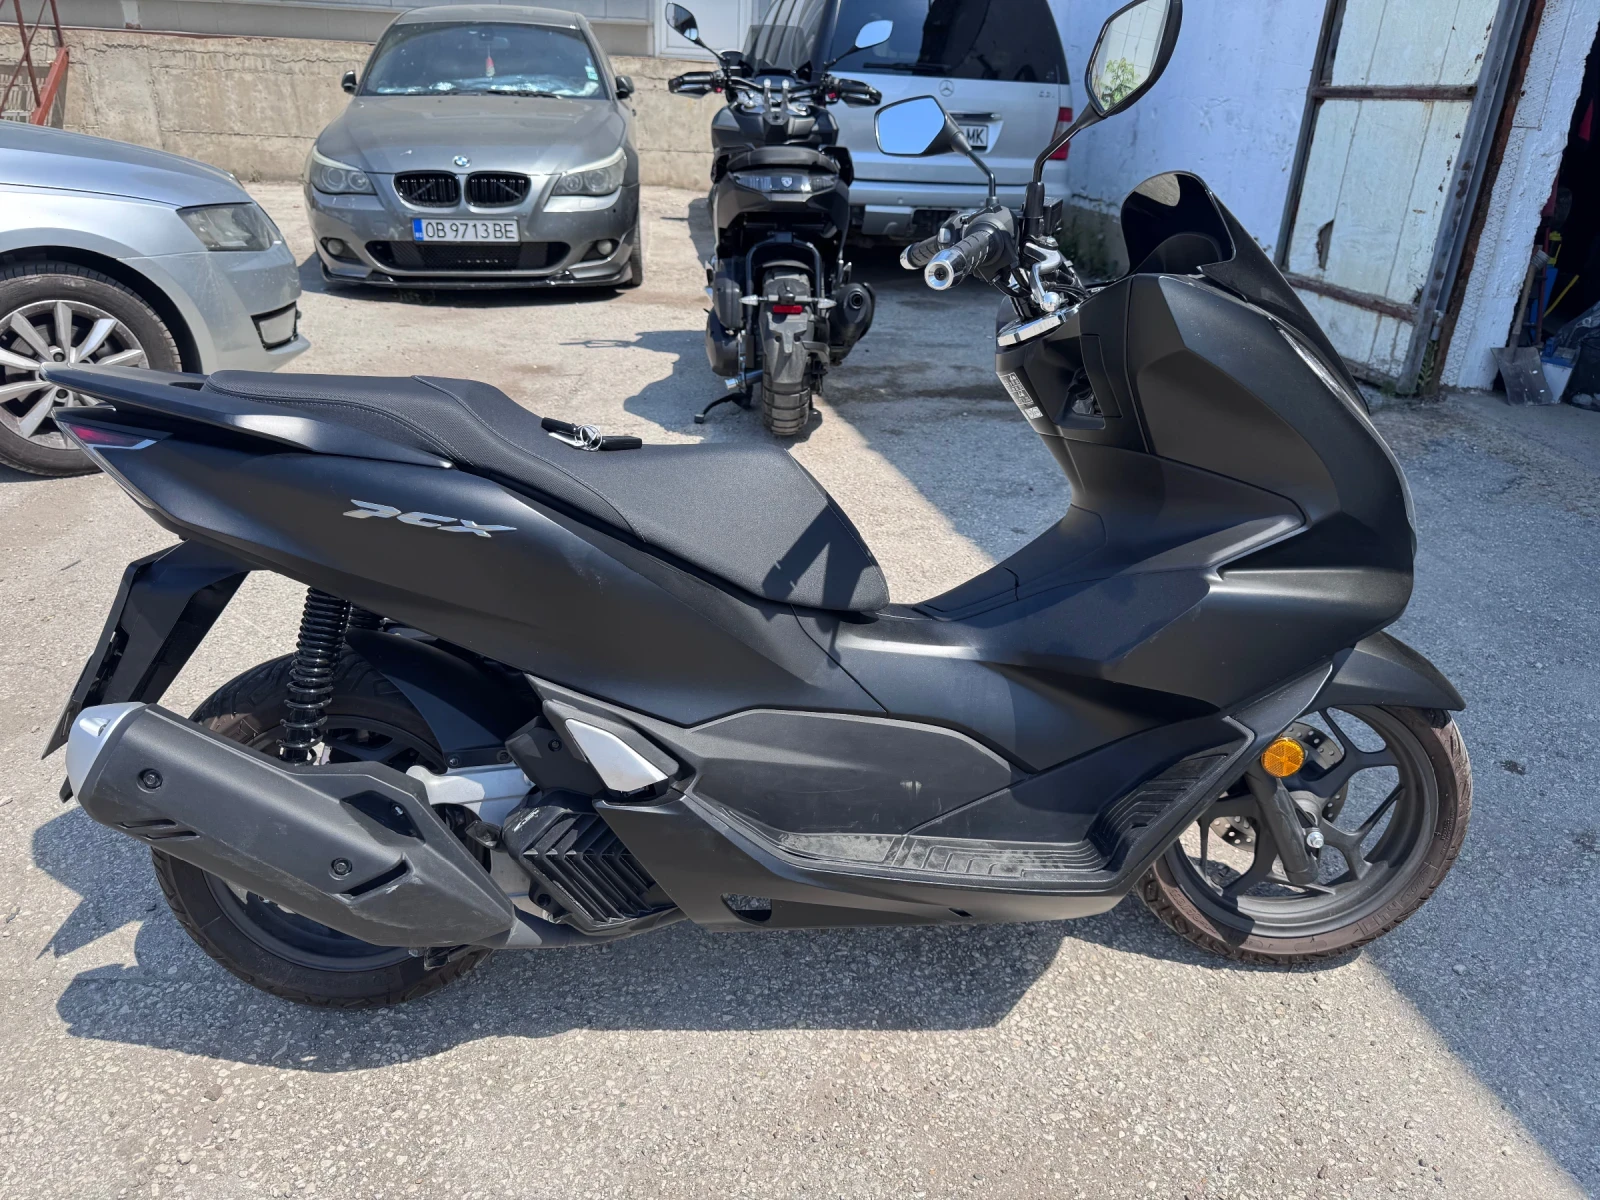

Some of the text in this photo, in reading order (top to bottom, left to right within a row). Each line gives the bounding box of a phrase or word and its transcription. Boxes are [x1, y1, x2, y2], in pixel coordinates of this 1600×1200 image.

[966, 128, 984, 145] MK
[450, 222, 490, 239] 9713
[493, 223, 516, 239] BE
[342, 499, 517, 538] PCX
